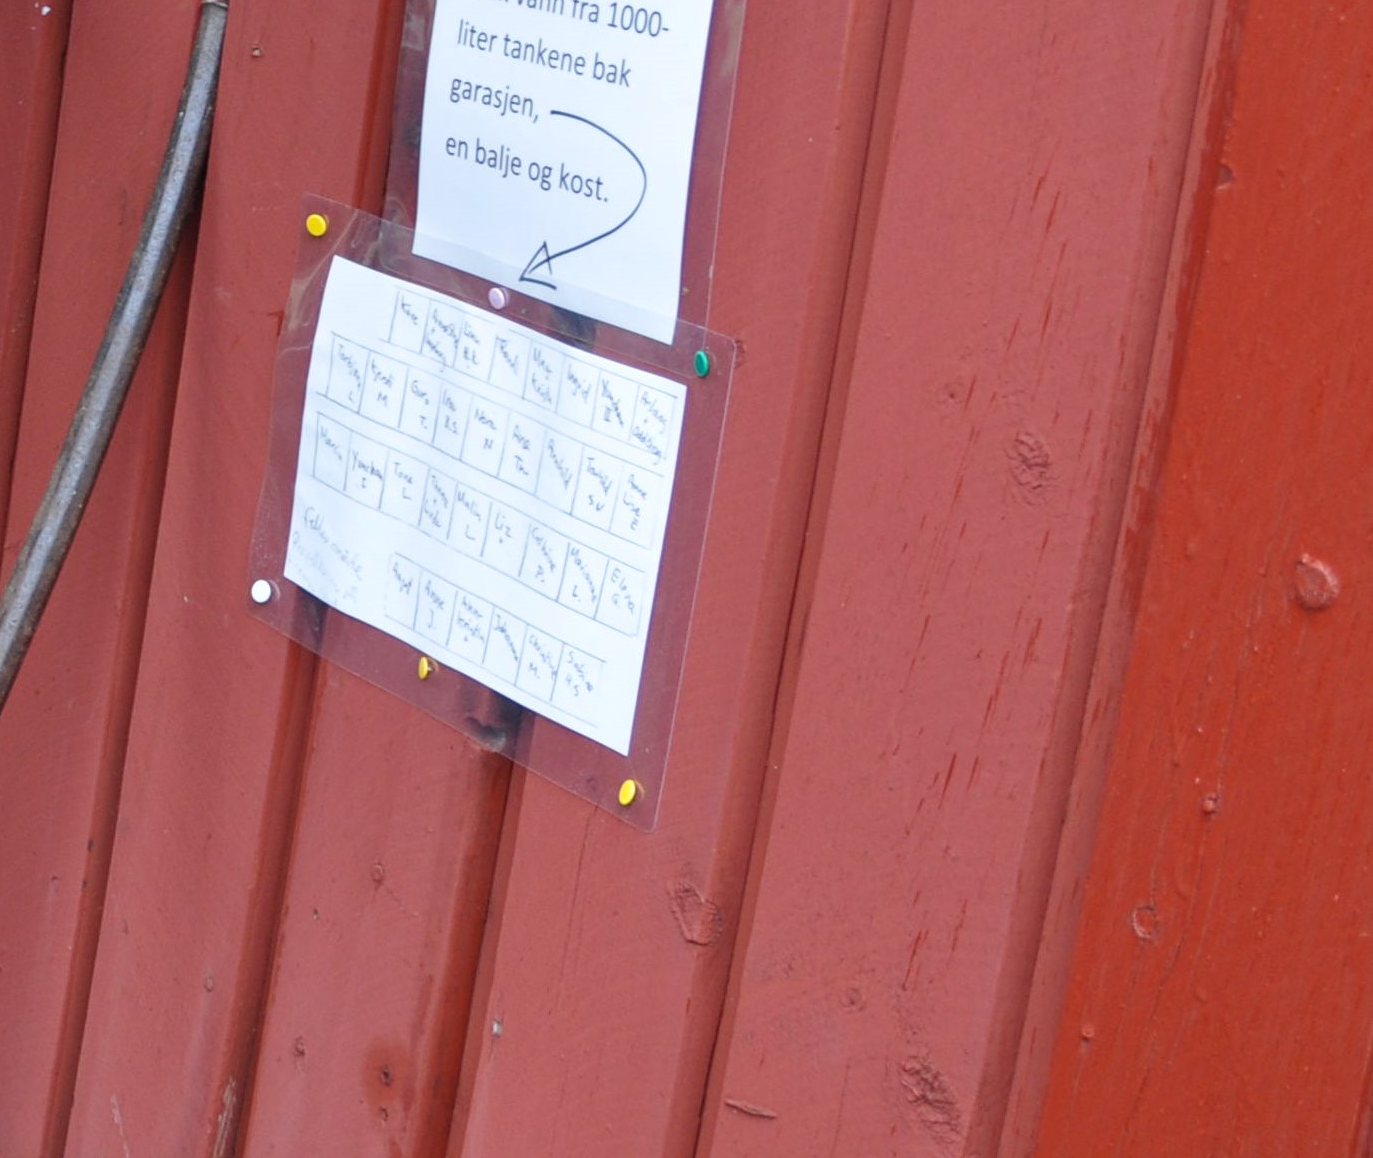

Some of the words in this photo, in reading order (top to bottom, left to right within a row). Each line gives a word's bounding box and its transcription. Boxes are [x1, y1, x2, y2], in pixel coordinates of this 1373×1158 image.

[607, 1, 670, 38] 1000-
[457, 19, 498, 52] liter
[503, 33, 586, 76] tankene
[592, 52, 632, 88] bak
[449, 78, 539, 123] garasjen,
[445, 137, 469, 160] en
[474, 137, 522, 179] balje
[528, 161, 553, 192] og
[558, 162, 608, 203] kost.
